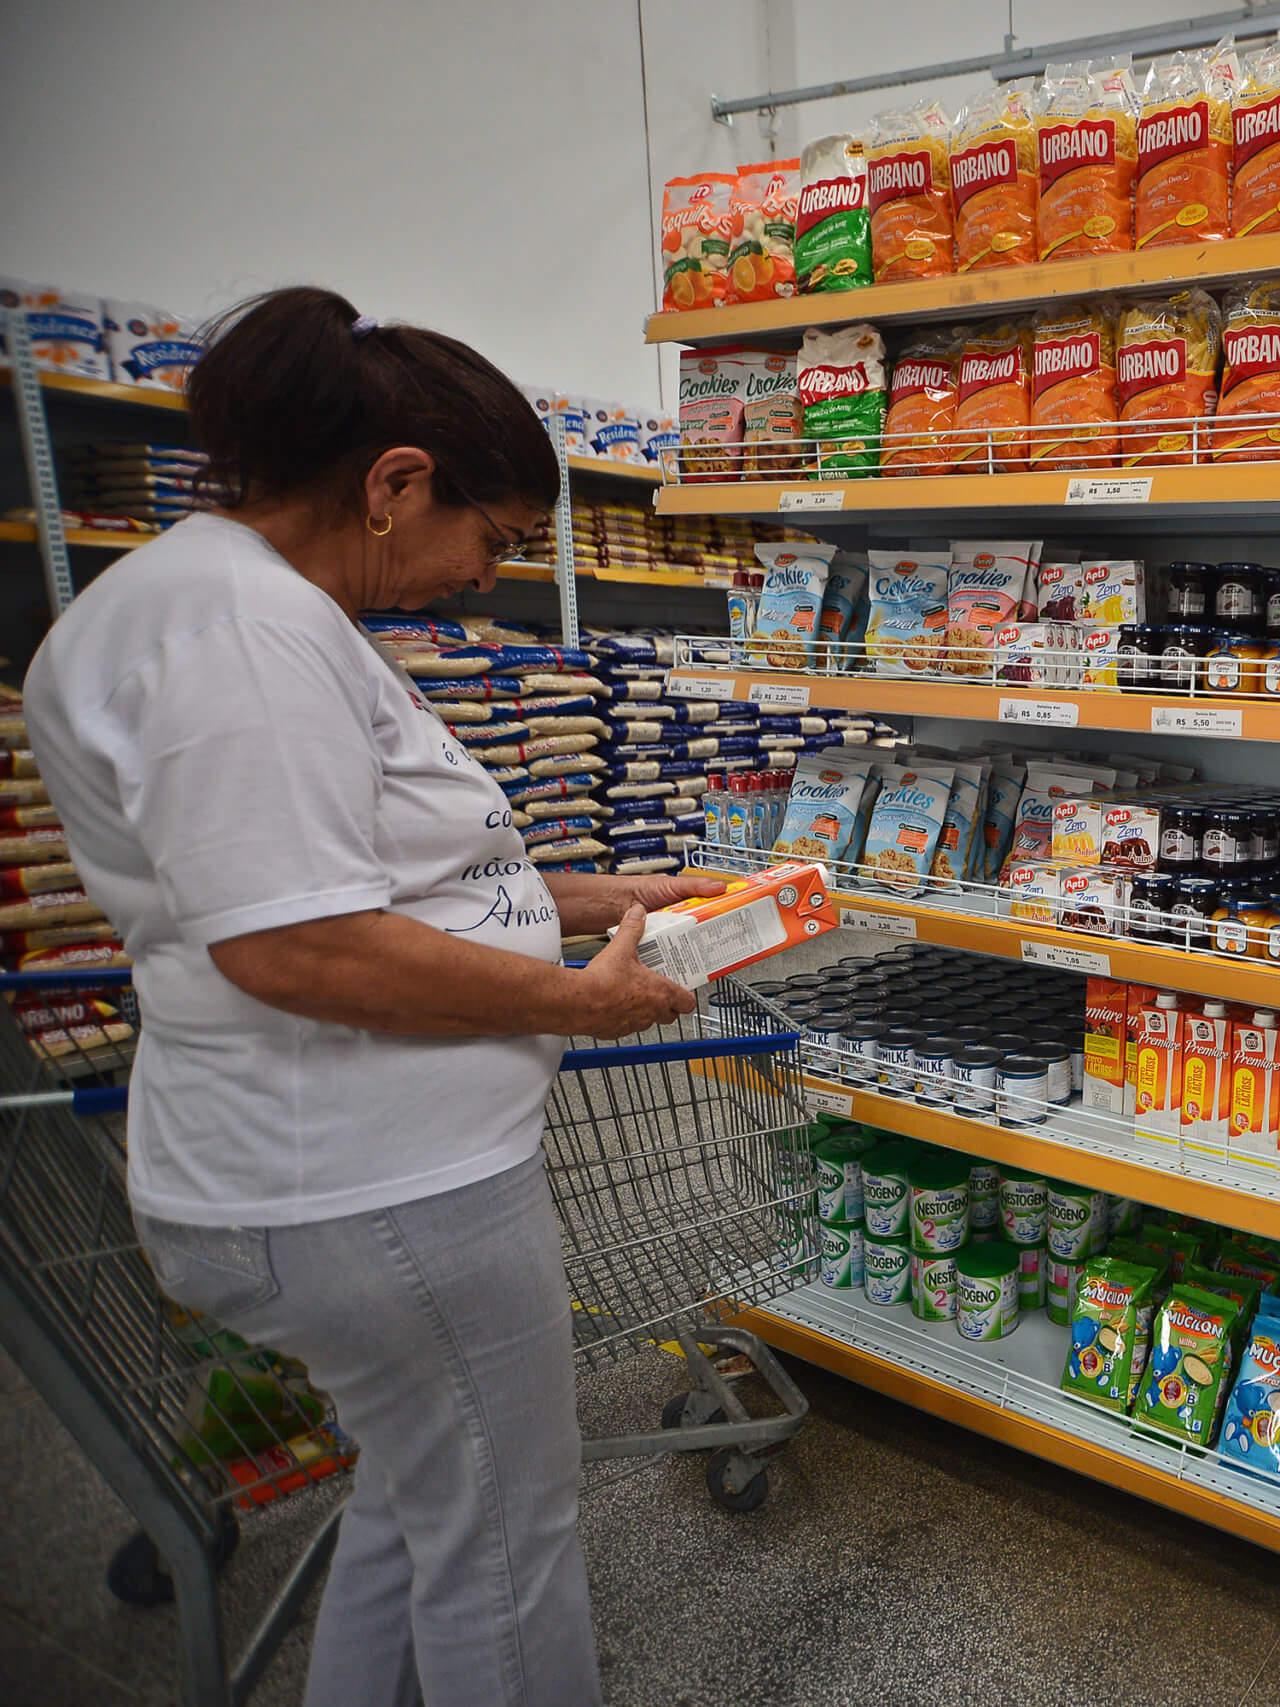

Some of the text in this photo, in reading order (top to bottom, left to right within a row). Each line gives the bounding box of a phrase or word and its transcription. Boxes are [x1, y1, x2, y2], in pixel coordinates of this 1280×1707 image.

[1138, 112, 1201, 154] URBANO
[1043, 129, 1108, 164] URBANO
[870, 161, 925, 193] URBANO
[953, 149, 1010, 189] URBANO
[802, 183, 860, 214] URBANO
[1035, 342, 1092, 375] URBANO
[1120, 349, 1179, 383] URBANO
[892, 365, 943, 391] URBANO
[961, 354, 1014, 384] URBANO
[680, 373, 740, 400] Cookies
[800, 367, 865, 393] URBANO
[1041, 570, 1060, 584] Apti
[1085, 568, 1105, 584] Apti
[876, 575, 936, 600] Cookies
[1051, 584, 1075, 600] Zero
[1097, 583, 1122, 600] Zero
[998, 629, 1018, 643] Apti
[1086, 634, 1106, 648] Apti
[1021, 710, 1030, 718] R$
[1176, 718, 1210, 728] R$ 5,50
[1054, 805, 1075, 819] Apti
[1106, 812, 1128, 826] Apti
[1064, 819, 1087, 836] Zero
[1117, 826, 1143, 842] Zero
[461, 856, 522, 881] não
[1013, 870, 1031, 884] Apti
[1065, 878, 1085, 892] Apti
[1138, 1031, 1182, 1051] Premiare
[1185, 1039, 1229, 1060] Premiare
[1086, 1062, 1113, 1074] LACTOSE
[1144, 1056, 1156, 1086] LACTOSE
[1193, 1065, 1204, 1097] LACTOSE
[1240, 1075, 1253, 1108] LACTOSE
[923, 1220, 936, 1239] 2
[1004, 1210, 1016, 1229] 2
[934, 1289, 948, 1308] 2
[1081, 1285, 1133, 1307] MUCILON
[1167, 1310, 1224, 1339] MUCILON
